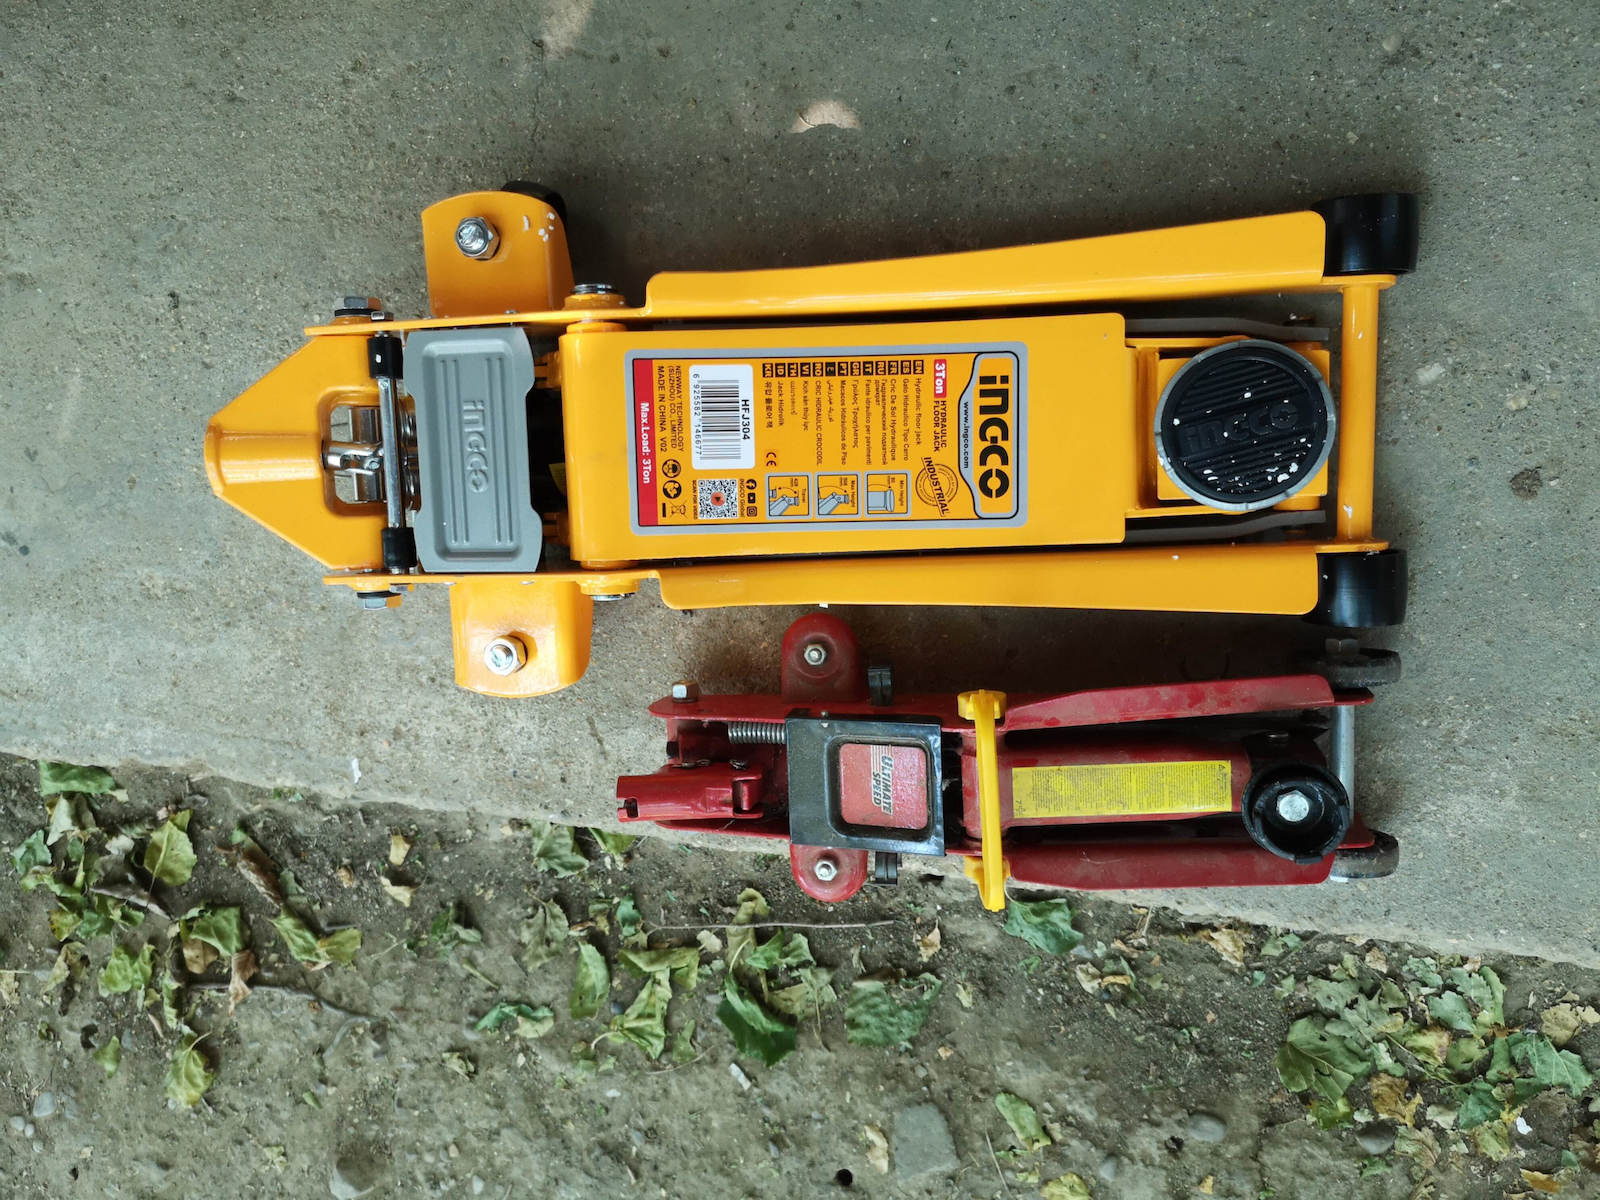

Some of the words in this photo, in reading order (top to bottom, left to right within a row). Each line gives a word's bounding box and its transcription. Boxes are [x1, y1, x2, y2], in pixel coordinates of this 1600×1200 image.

[936, 363, 946, 394] 3Ton
[890, 395, 896, 404] De
[641, 402, 650, 456] Max.Load:
[742, 400, 750, 440] HFJ304
[642, 459, 651, 484] 3Ton
[924, 457, 949, 514] INDUSTRIAL
[872, 772, 881, 806] SPEED
